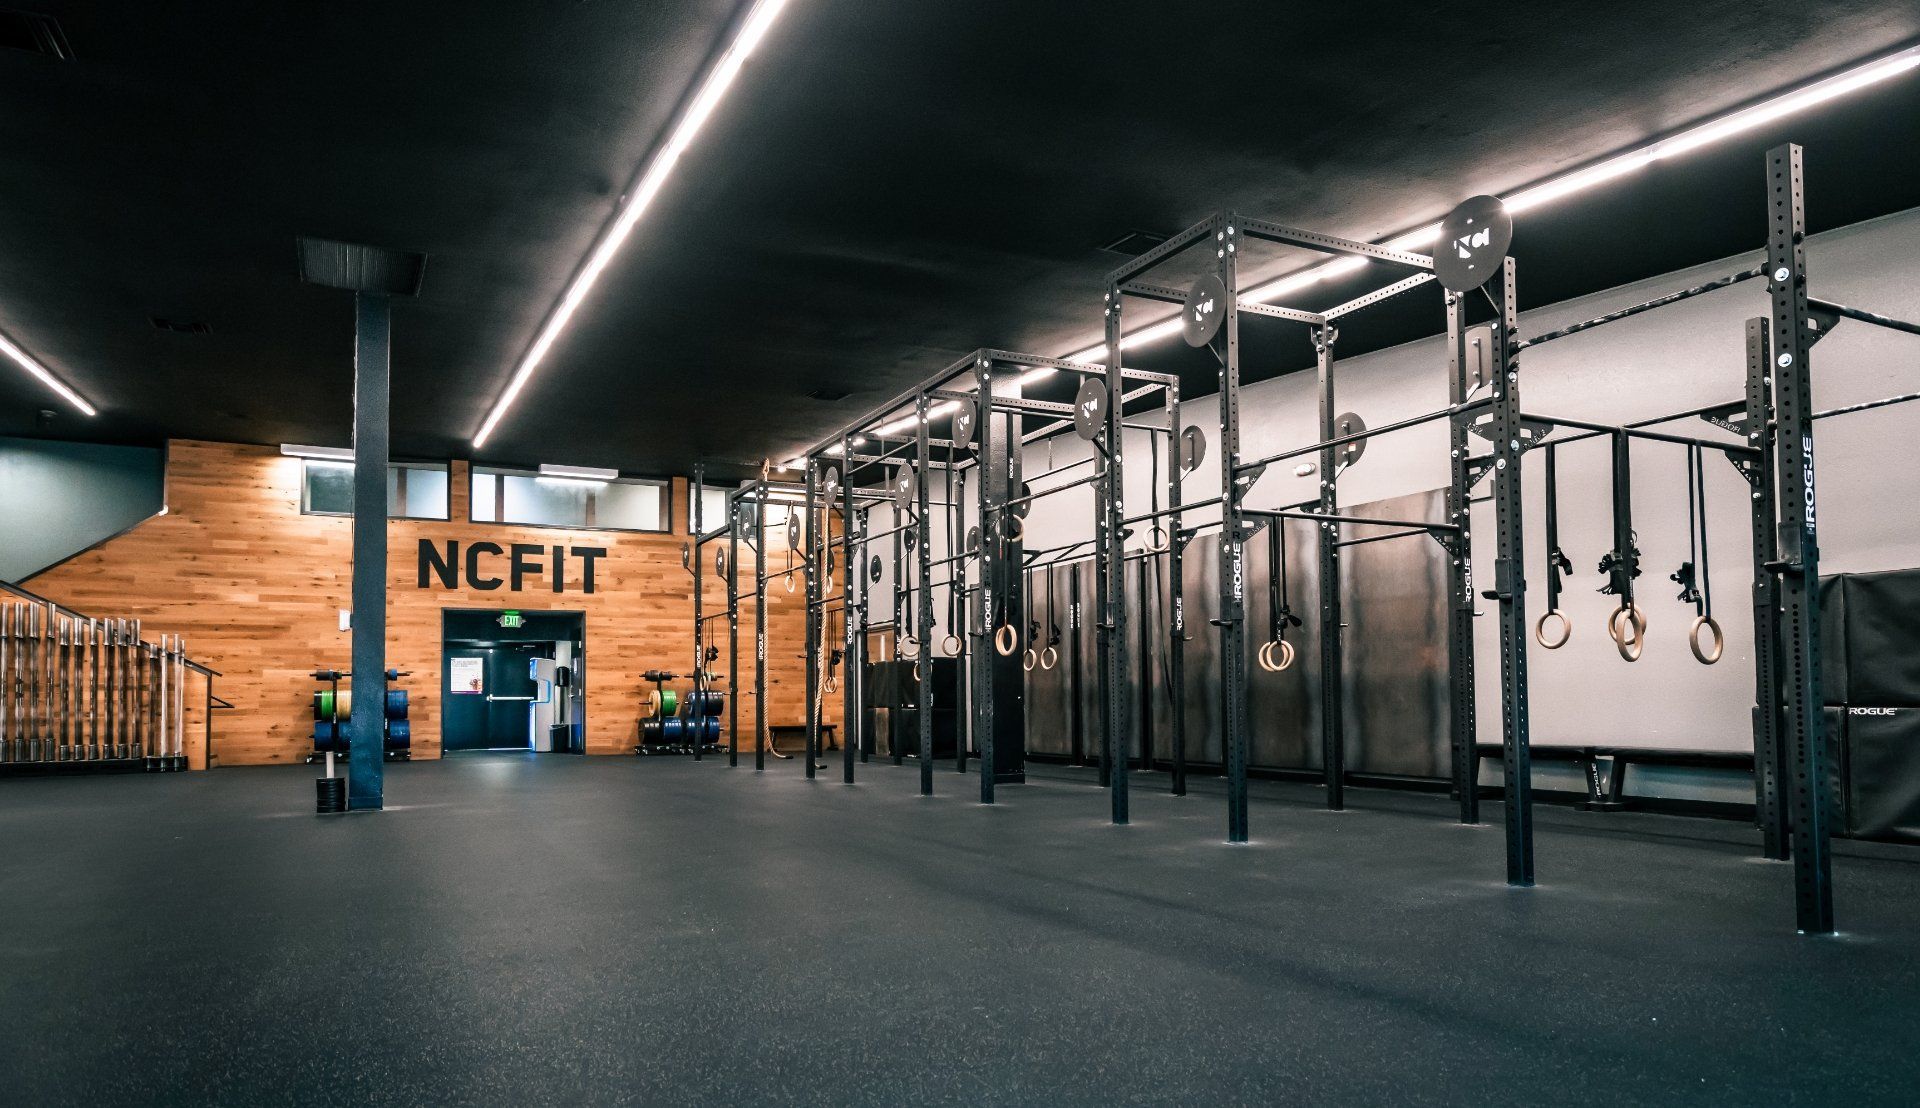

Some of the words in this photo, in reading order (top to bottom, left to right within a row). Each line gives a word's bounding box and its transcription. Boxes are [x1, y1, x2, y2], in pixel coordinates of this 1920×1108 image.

[1803, 436, 1815, 523] ROGUE
[418, 539, 607, 594] NCFIT
[1232, 541, 1242, 596] ROGUE
[1464, 558, 1472, 602] ROGUE
[504, 615, 519, 626] EXIT
[984, 589, 992, 628] ROGUE
[1849, 708, 1896, 716] ROGUE
